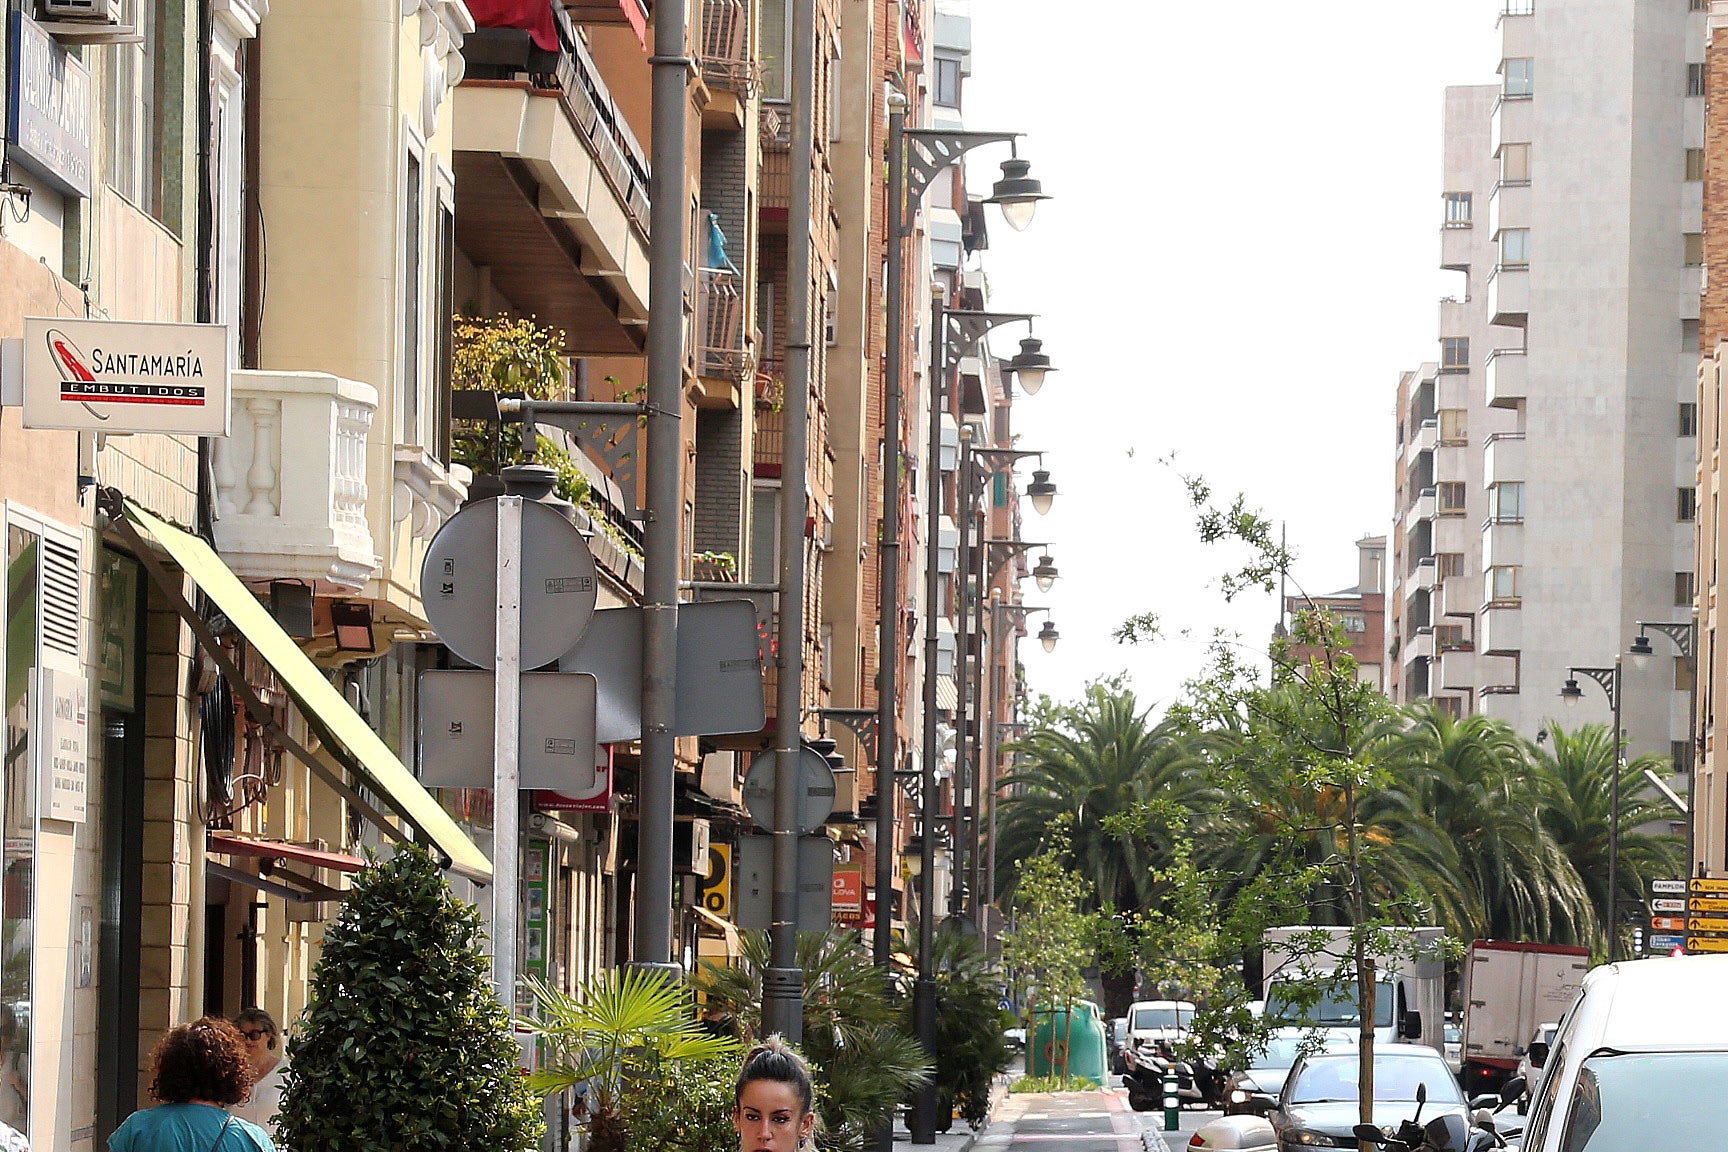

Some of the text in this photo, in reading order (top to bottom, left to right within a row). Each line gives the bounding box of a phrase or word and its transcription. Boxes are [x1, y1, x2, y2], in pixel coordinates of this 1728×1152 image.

[91, 348, 203, 378] SANTAMARÍA
[70, 383, 199, 397] EMBUTIDOS
[1653, 882, 1685, 890] PAMPLON
